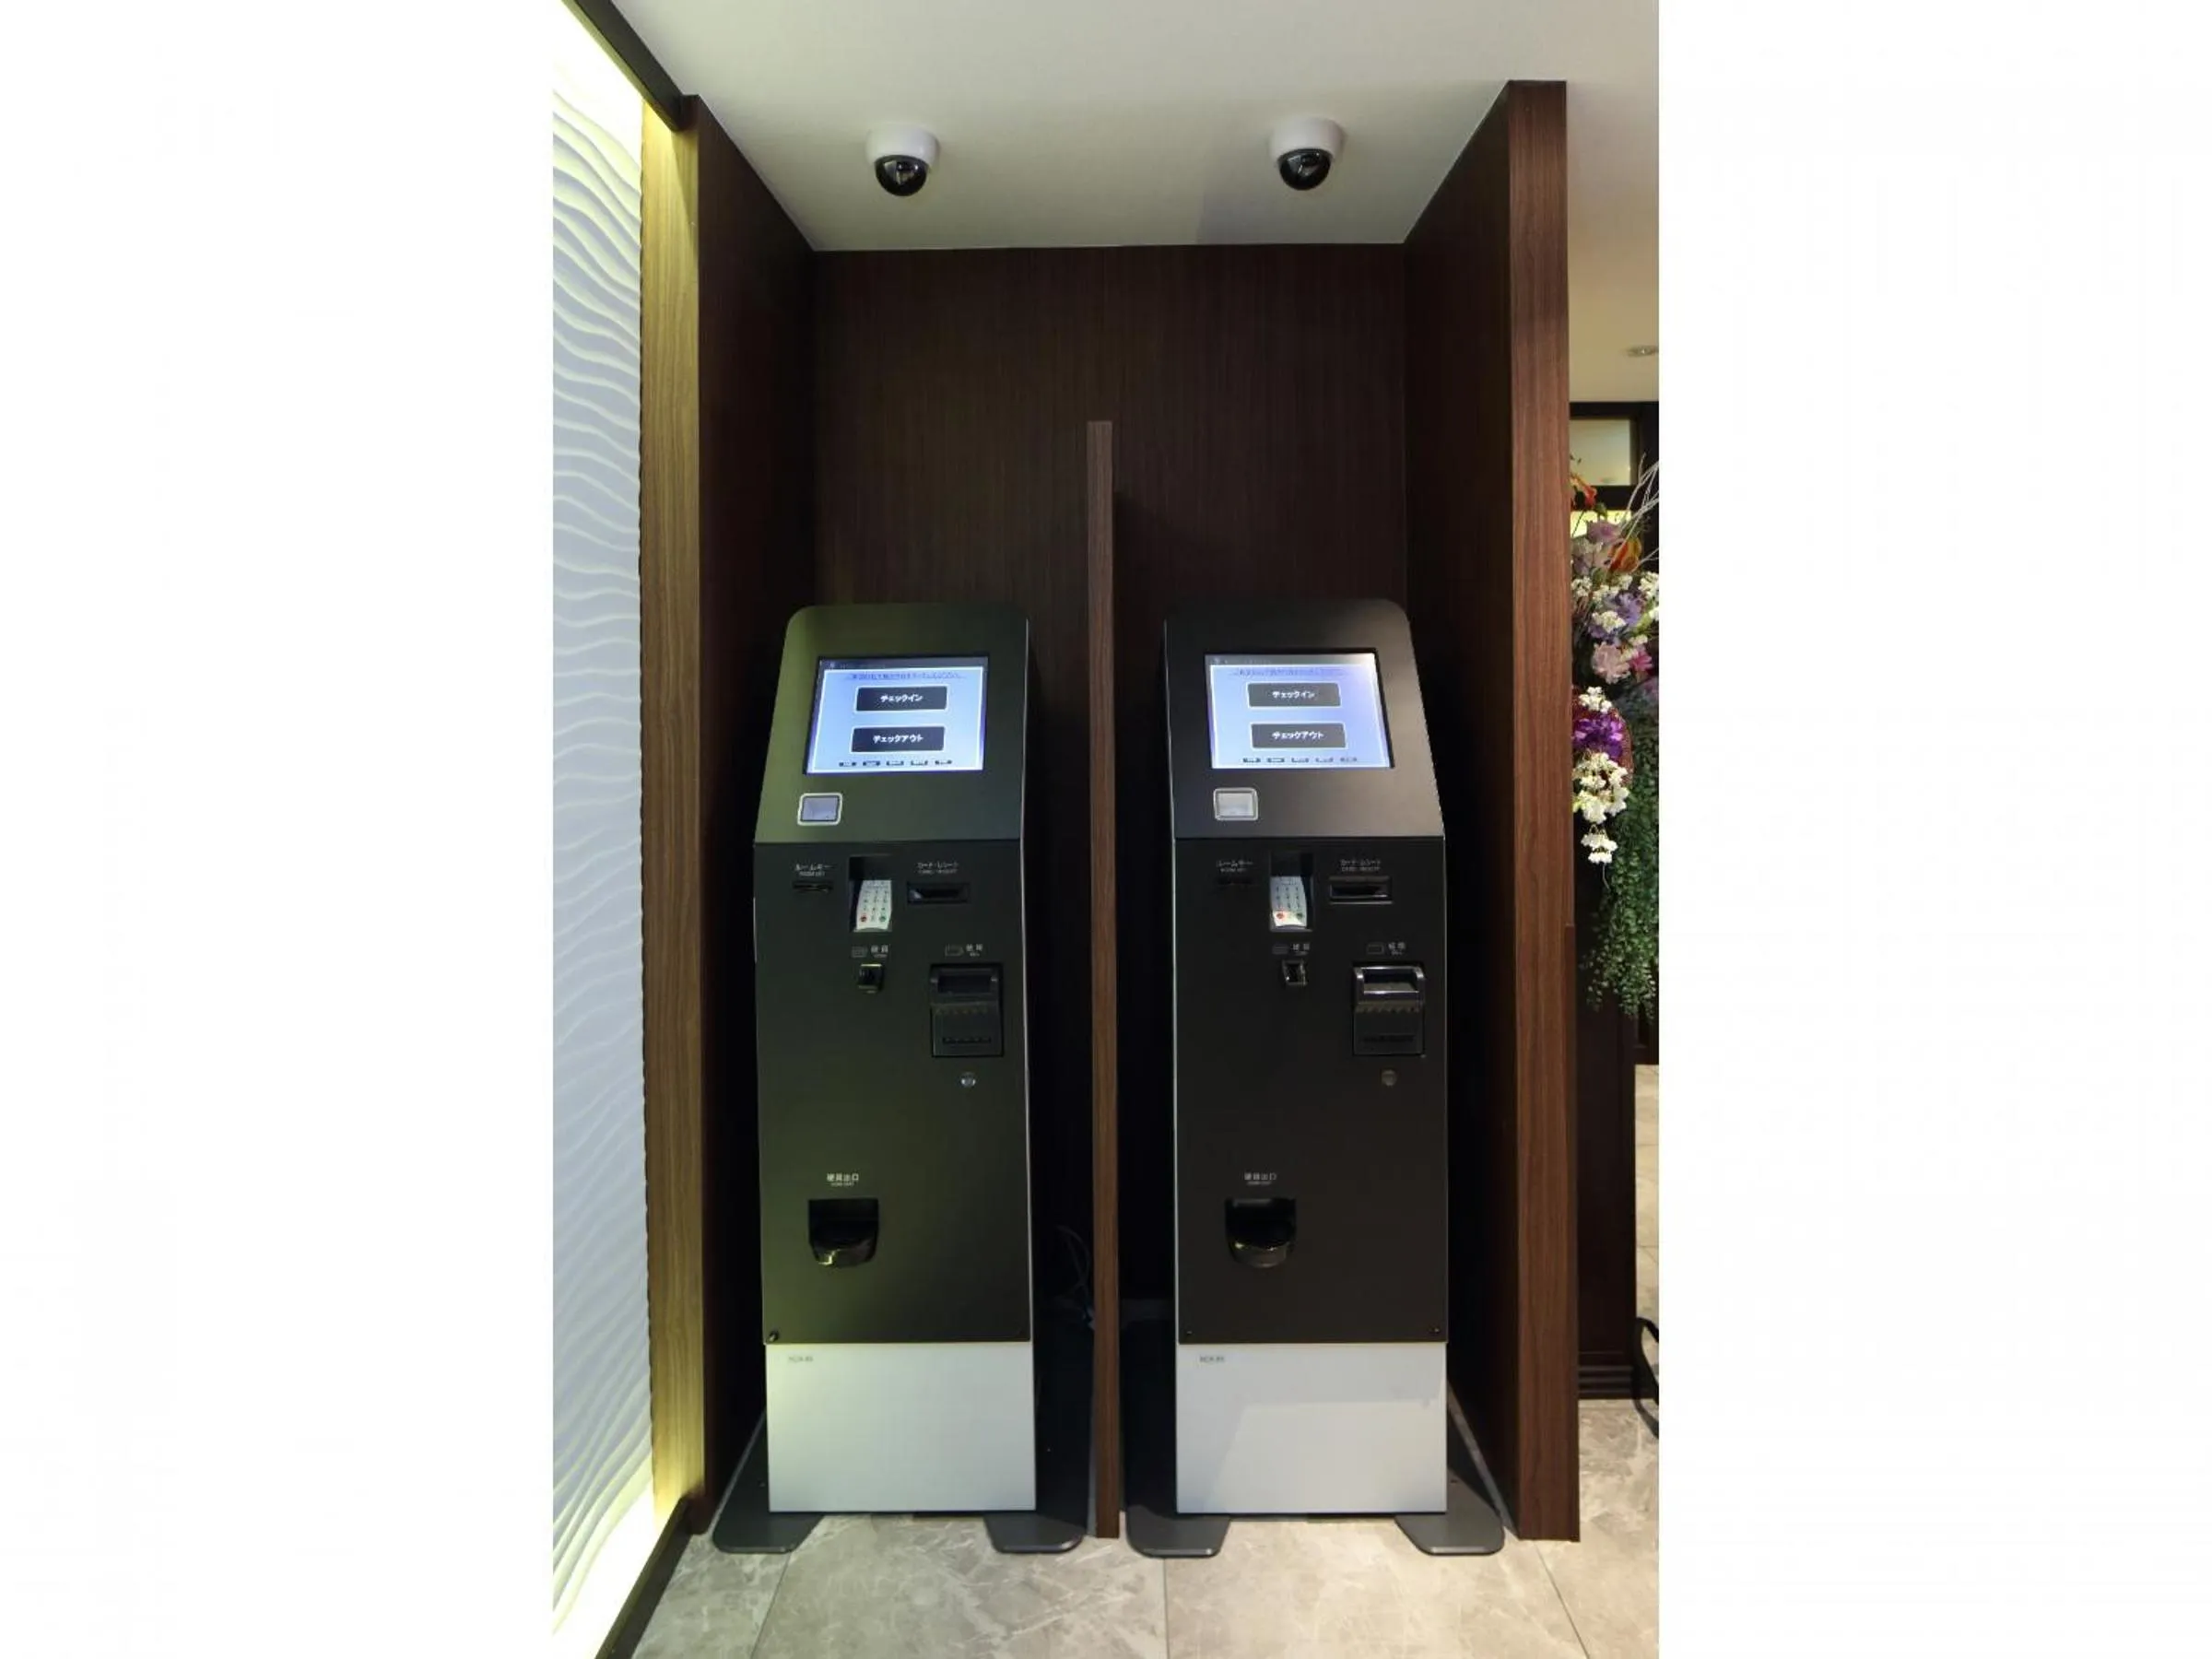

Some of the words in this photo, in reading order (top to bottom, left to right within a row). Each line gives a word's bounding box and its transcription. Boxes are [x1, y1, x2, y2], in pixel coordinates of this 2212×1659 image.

[880, 693, 924, 703] チェックイン
[1272, 690, 1316, 700] チェックイン
[872, 734, 924, 745] チェックアウト
[1271, 730, 1325, 741] チェックアウト
